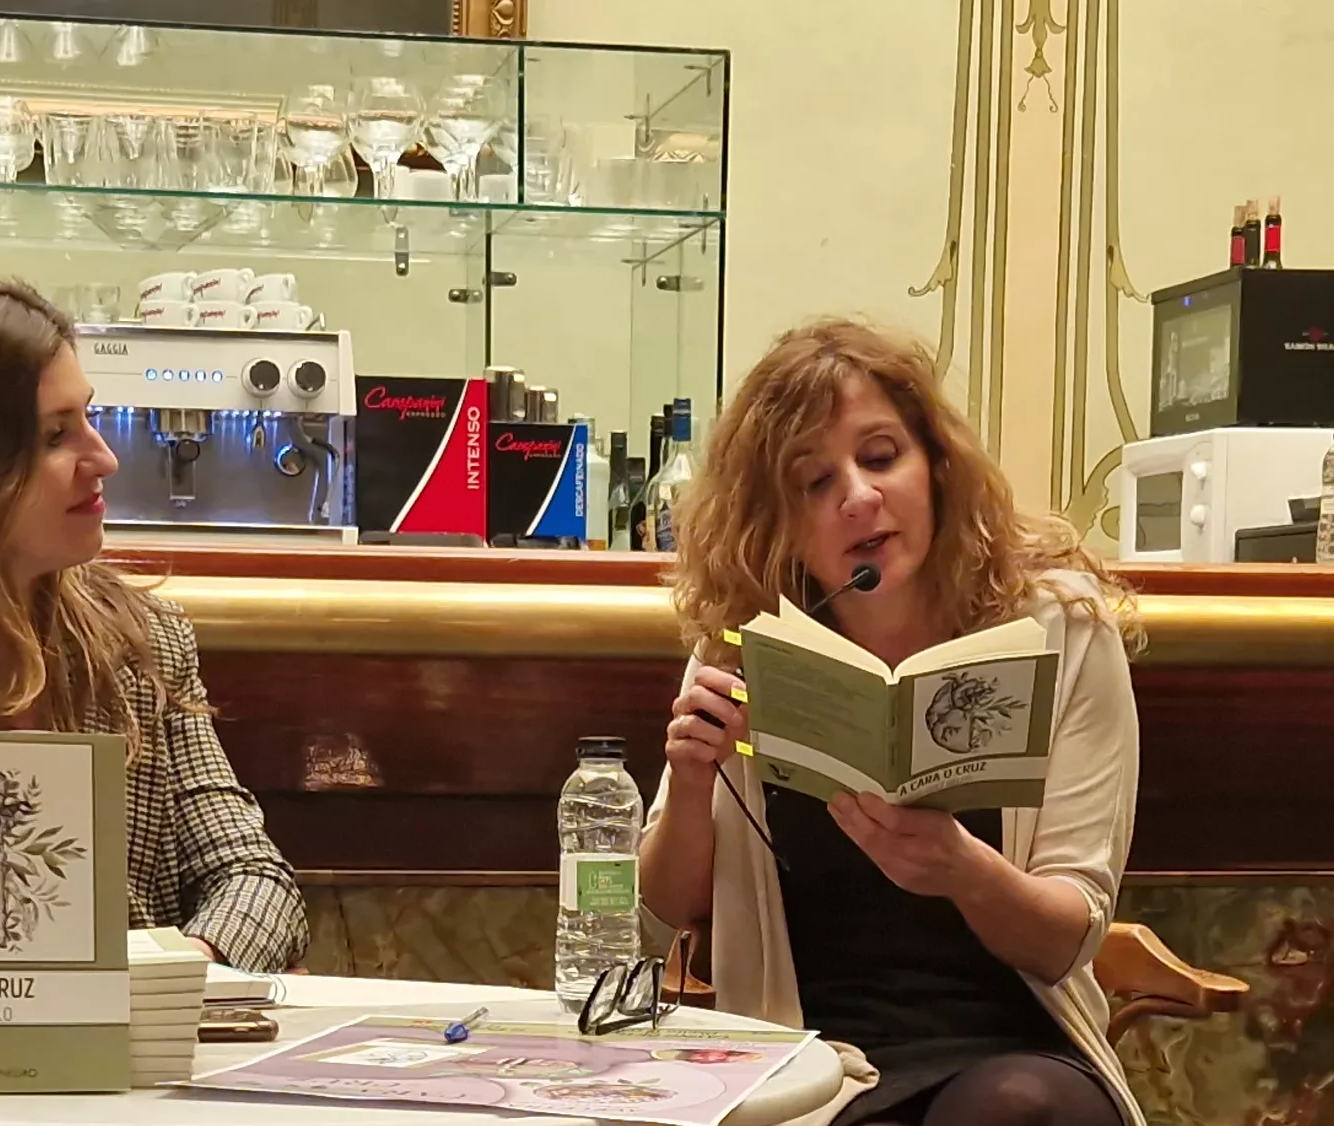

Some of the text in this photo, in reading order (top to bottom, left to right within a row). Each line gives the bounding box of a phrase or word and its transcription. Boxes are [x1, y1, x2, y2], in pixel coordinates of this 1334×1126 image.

[94, 343, 128, 355] GAGGIA
[467, 406, 480, 490] INTENSO
[899, 786, 907, 796] A
[910, 772, 940, 791] CARA
[944, 768, 952, 779] O
[955, 761, 987, 777] CRUZ
